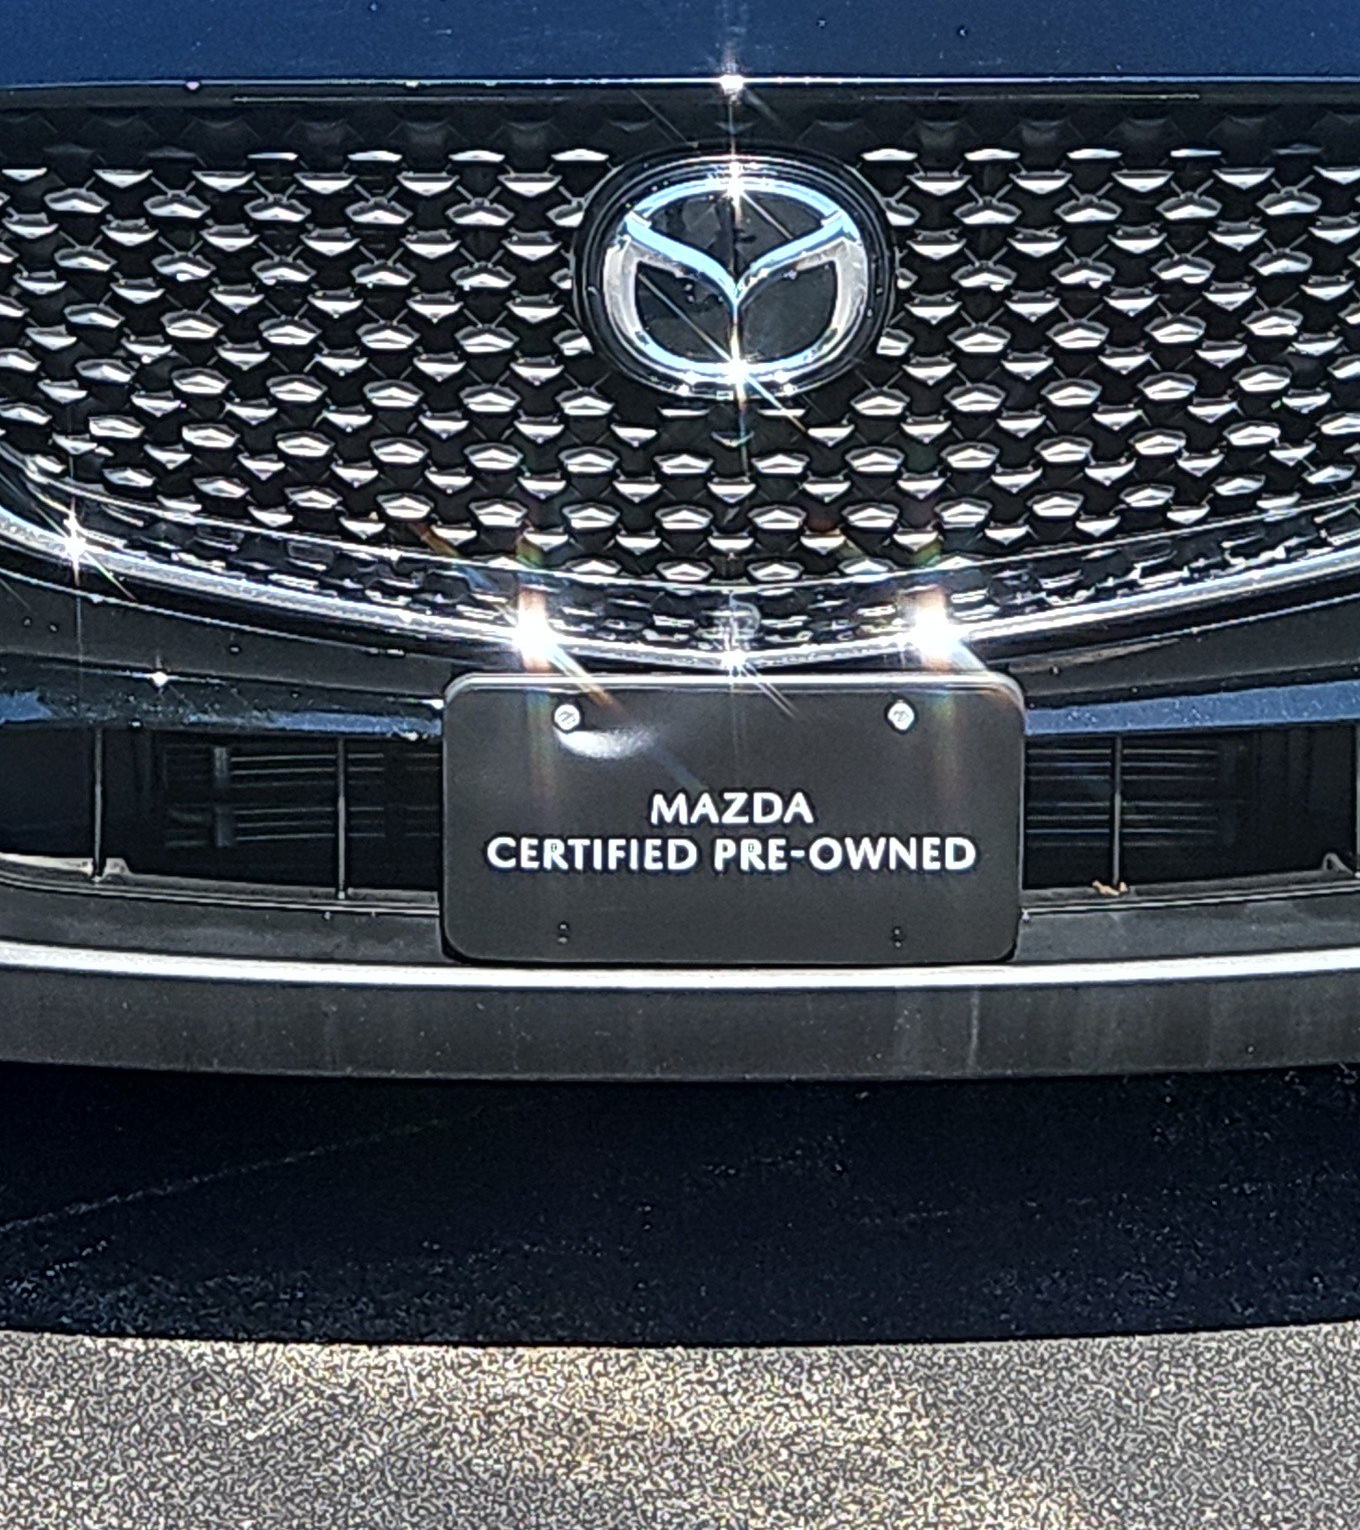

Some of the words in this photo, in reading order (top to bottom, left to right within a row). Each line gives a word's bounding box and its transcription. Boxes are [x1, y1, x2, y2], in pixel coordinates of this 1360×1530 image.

[651, 791, 814, 825] MAZDA
[486, 836, 698, 871] CERTIFIED
[714, 836, 977, 871] PRE-OWNED
